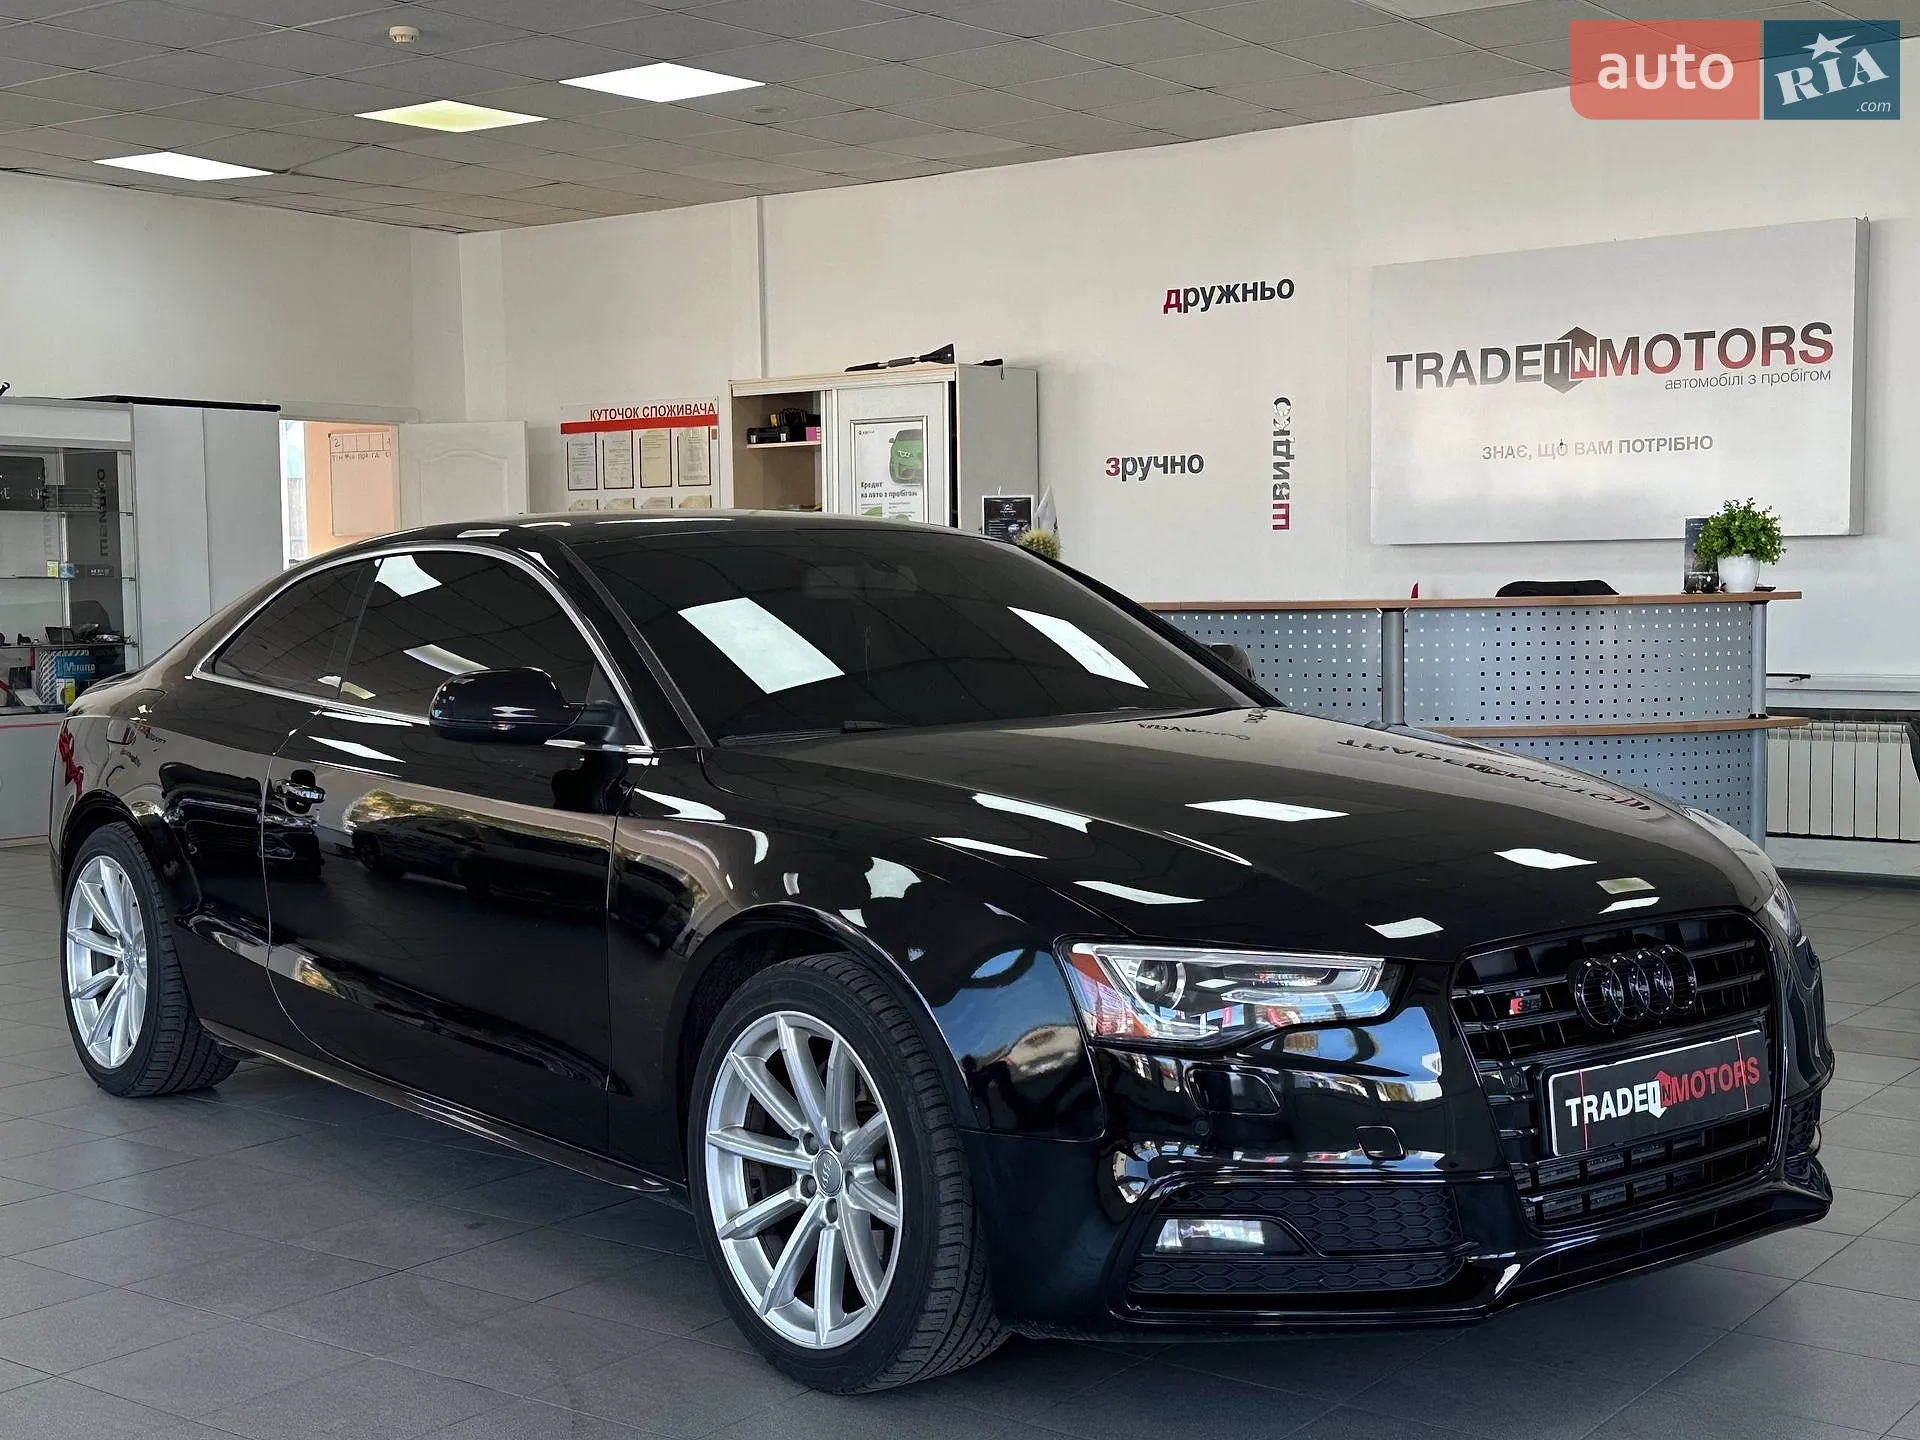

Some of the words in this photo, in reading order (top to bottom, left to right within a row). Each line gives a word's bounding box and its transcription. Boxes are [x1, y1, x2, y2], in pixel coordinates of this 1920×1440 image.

[1163, 278, 1295, 314] дружньо
[1664, 373, 1744, 391] автомобілі
[1748, 373, 1757, 385] з
[1761, 368, 1831, 387] пробігом
[590, 406, 640, 421] КУТОЧОК
[642, 402, 716, 418] СПОЖИВАЧА
[1574, 440, 1613, 456] ВАМ
[1618, 435, 1714, 454] ПОТРІБНО
[1105, 454, 1205, 481] зручно
